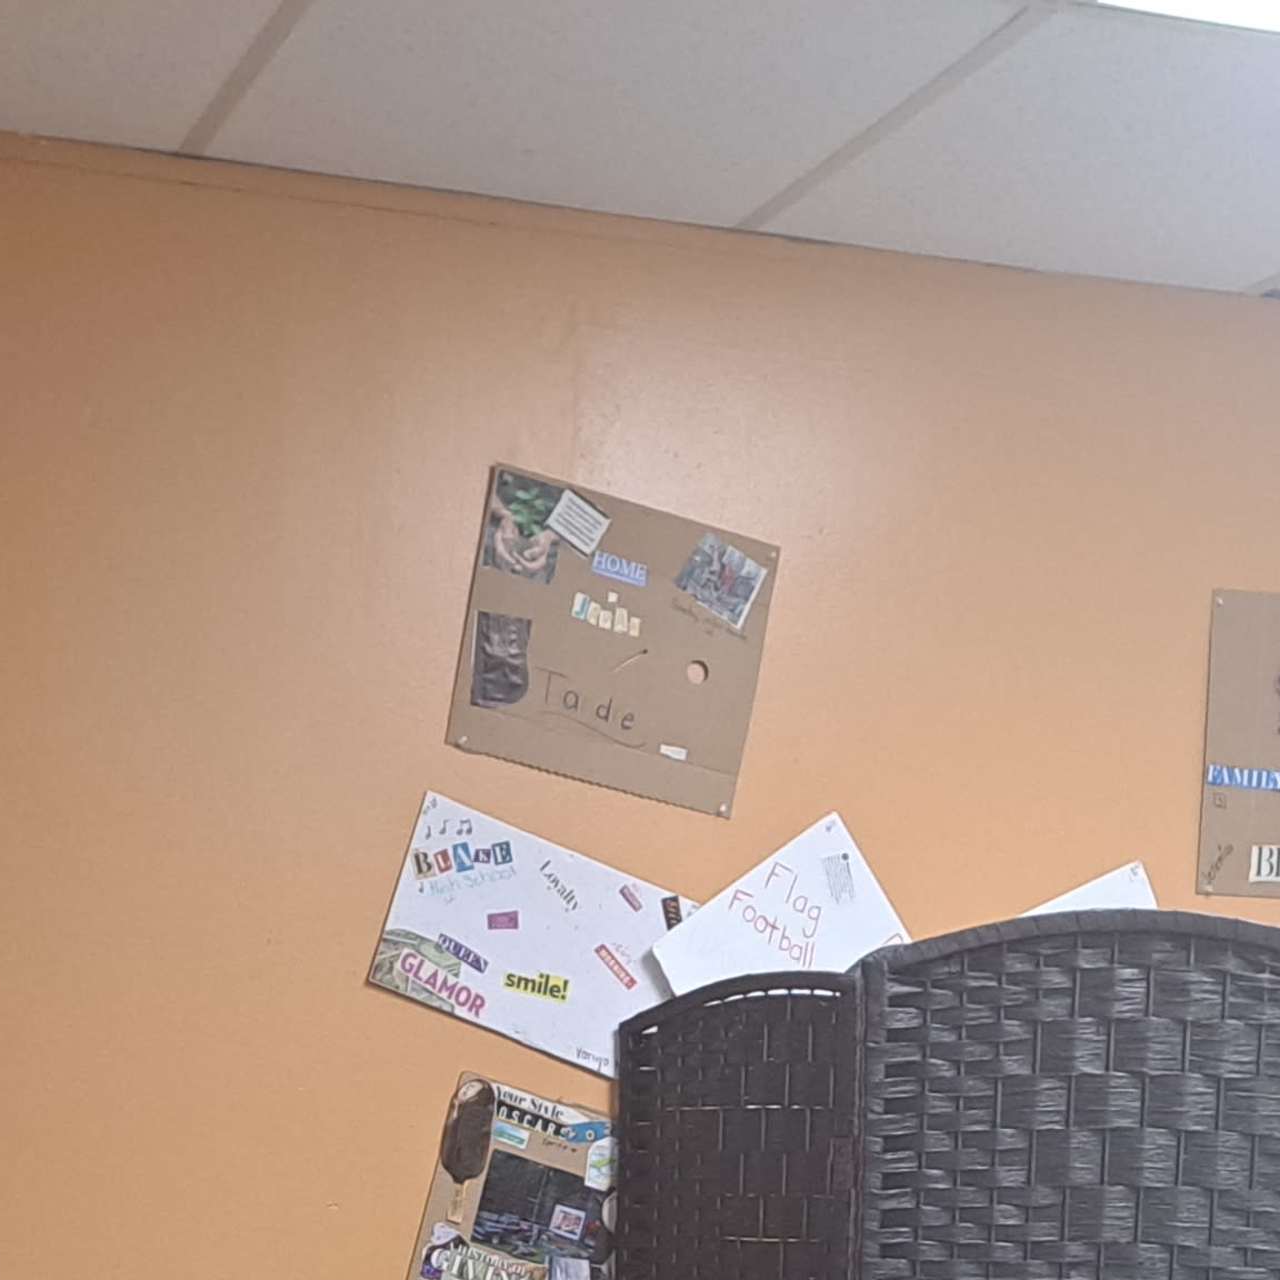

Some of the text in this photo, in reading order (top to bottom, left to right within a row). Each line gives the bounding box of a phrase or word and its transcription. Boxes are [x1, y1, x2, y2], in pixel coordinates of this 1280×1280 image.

[593, 551, 647, 579] HOME
[539, 860, 579, 912] Loyalty
[764, 861, 822, 939] Flag
[728, 888, 816, 969] Football
[400, 952, 486, 1019] GLAMOR
[505, 971, 570, 1000] smile!
